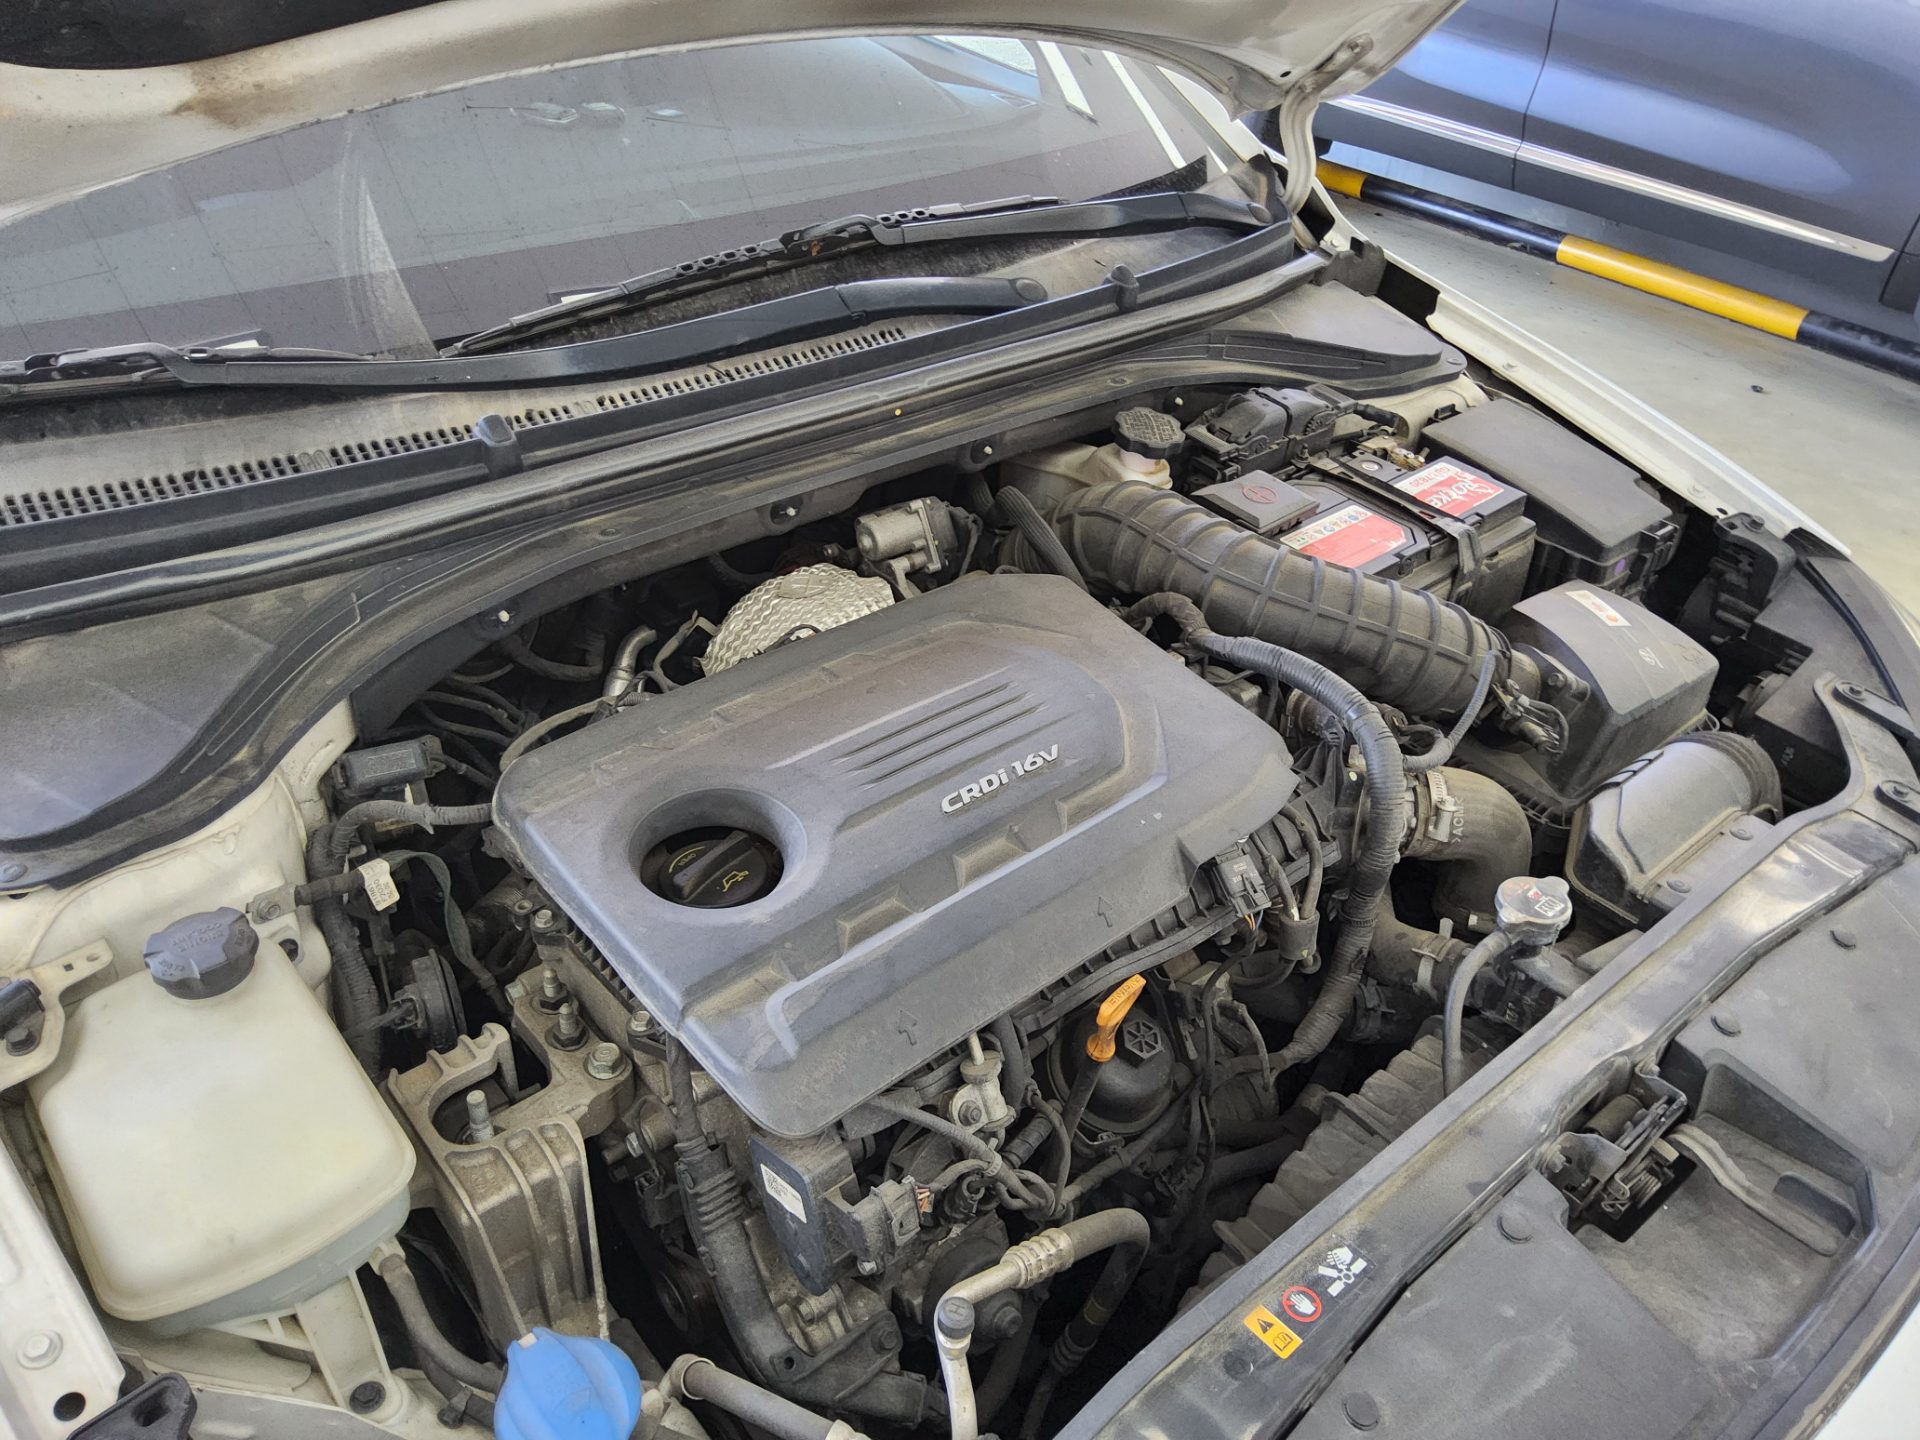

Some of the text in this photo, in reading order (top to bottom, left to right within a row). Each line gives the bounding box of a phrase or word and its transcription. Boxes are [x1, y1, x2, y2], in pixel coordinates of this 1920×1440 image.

[1429, 479, 1477, 507] ROCKE
[941, 743, 1059, 813] CRDi 16V
